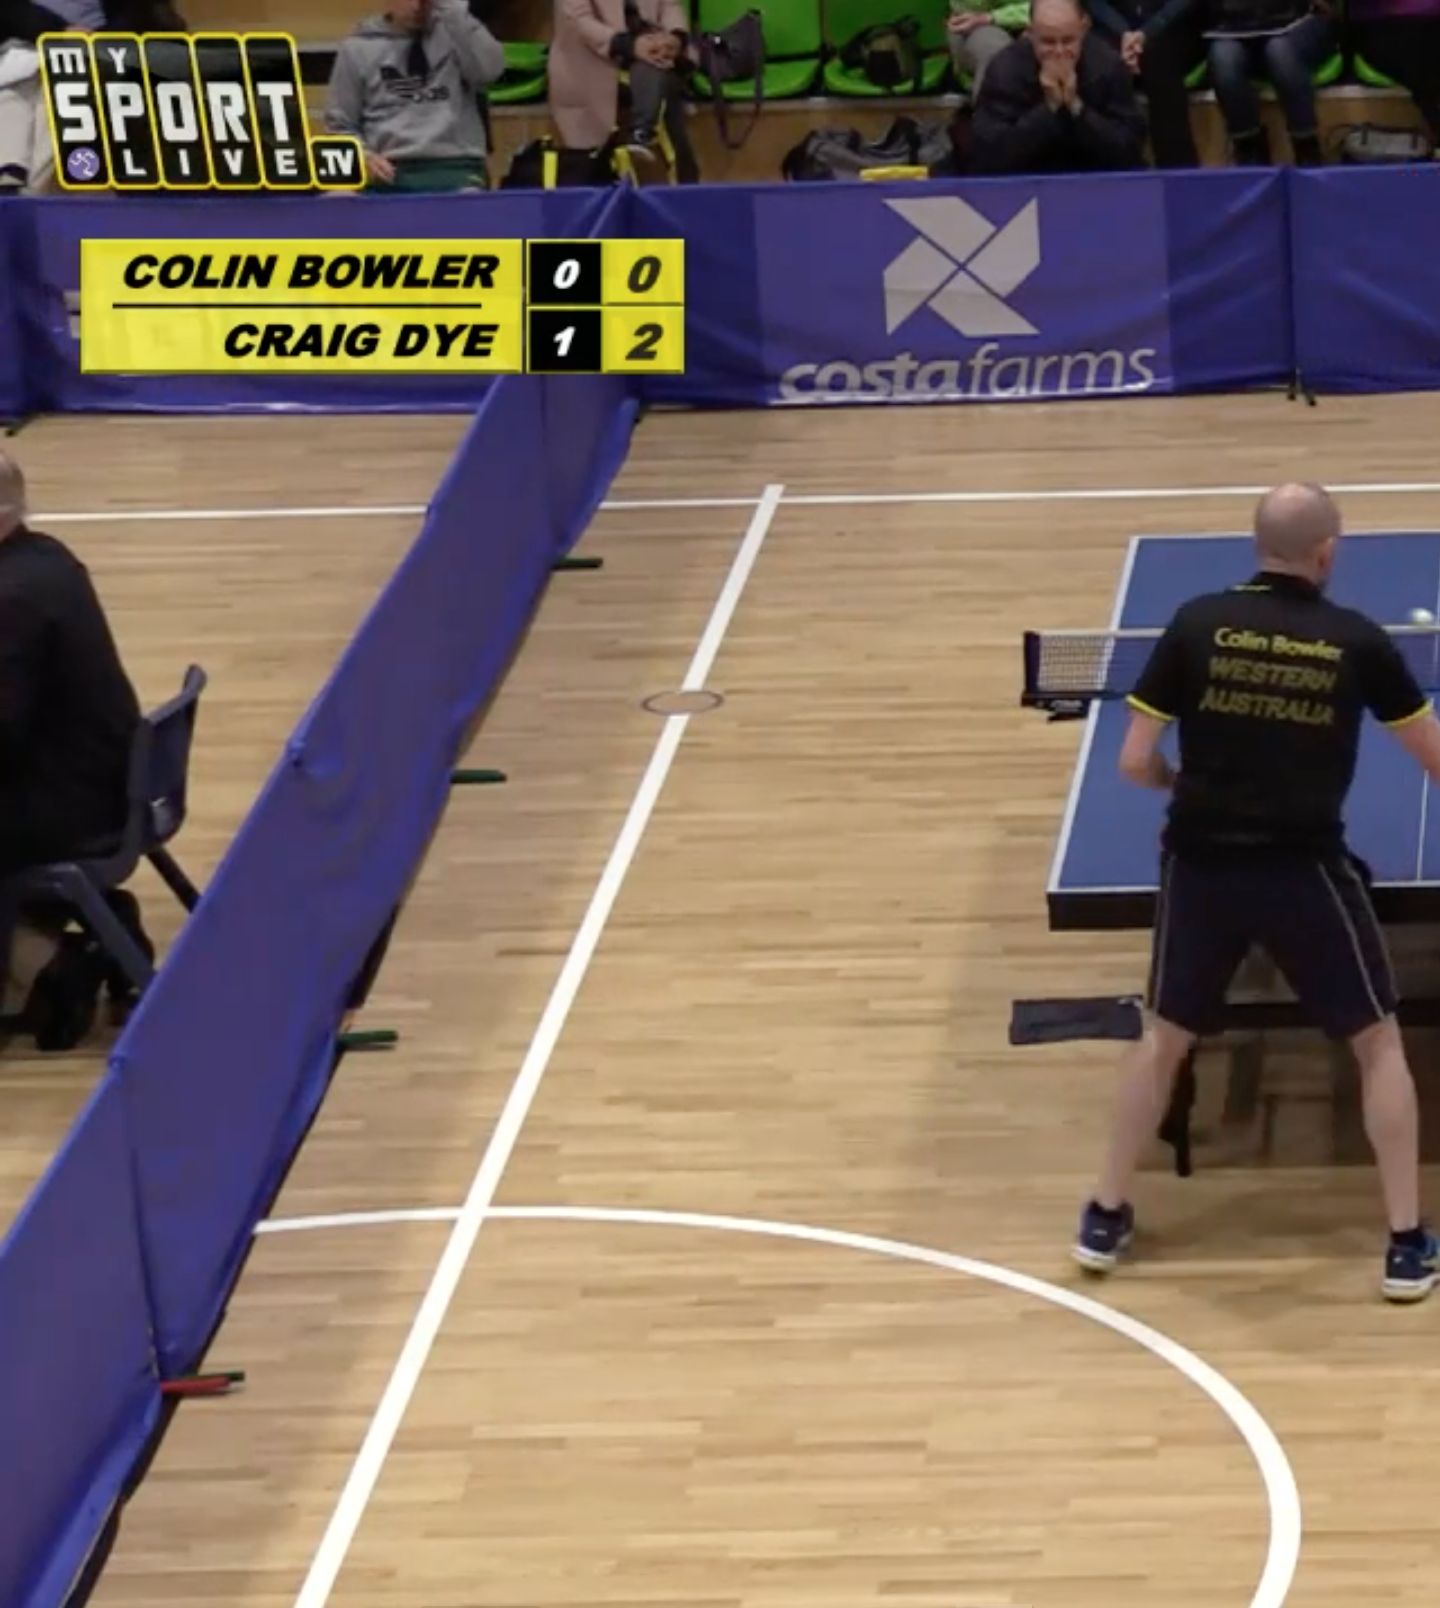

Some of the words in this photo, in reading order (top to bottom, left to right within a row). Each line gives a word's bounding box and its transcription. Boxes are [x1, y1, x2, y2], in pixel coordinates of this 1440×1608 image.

[1213, 626, 1269, 651] Colin
[1271, 633, 1344, 662] Bowler
[1209, 655, 1338, 692] WESTERN
[1198, 686, 1335, 725] AUSTRALIA
